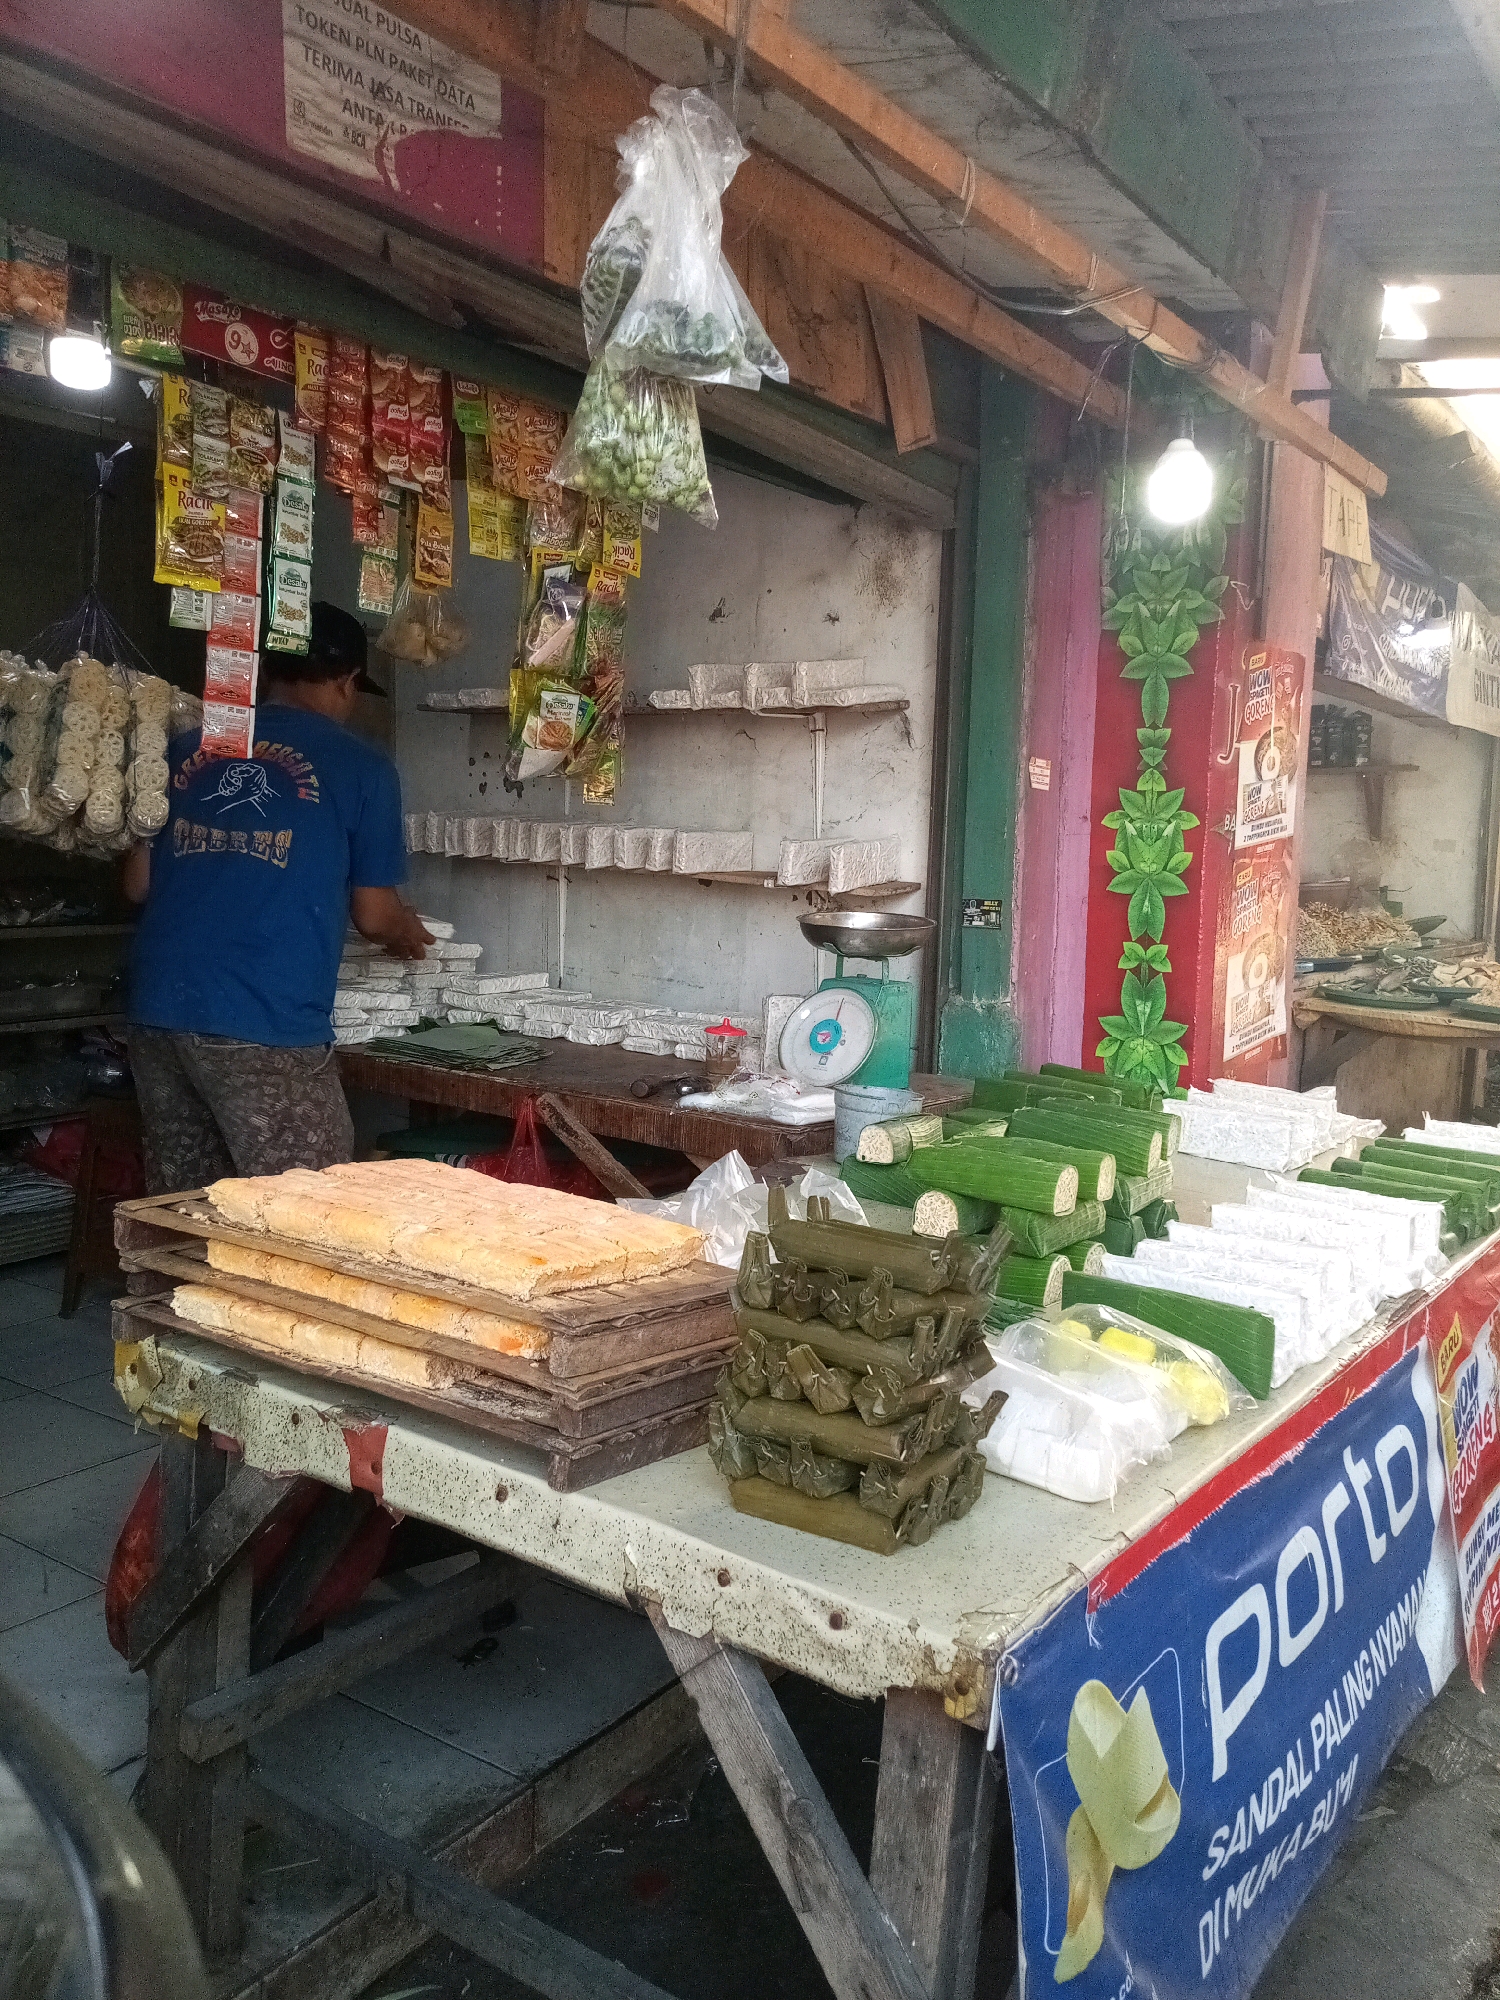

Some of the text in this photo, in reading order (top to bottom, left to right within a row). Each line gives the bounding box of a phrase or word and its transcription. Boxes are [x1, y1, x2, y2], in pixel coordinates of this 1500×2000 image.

[376, 11, 422, 51] PULSA
[295, 4, 475, 112] TOKEN PLN PAKET DATA
[302, 43, 365, 89] TERIMA
[369, 77, 405, 110] JASA
[264, 357, 295, 375] AJINO
[178, 490, 214, 511] Racik
[612, 545, 635, 560] Racik
[1249, 668, 1271, 692] WOW
[1440, 1325, 1460, 1375] BARU
[1452, 1402, 1494, 1514] GORENG
[1202, 1739, 1313, 1881] SANDAL
[1310, 1650, 1373, 1772] PALING
[1199, 1896, 1220, 1979] DI
[1224, 1822, 1303, 1940] MUKA
